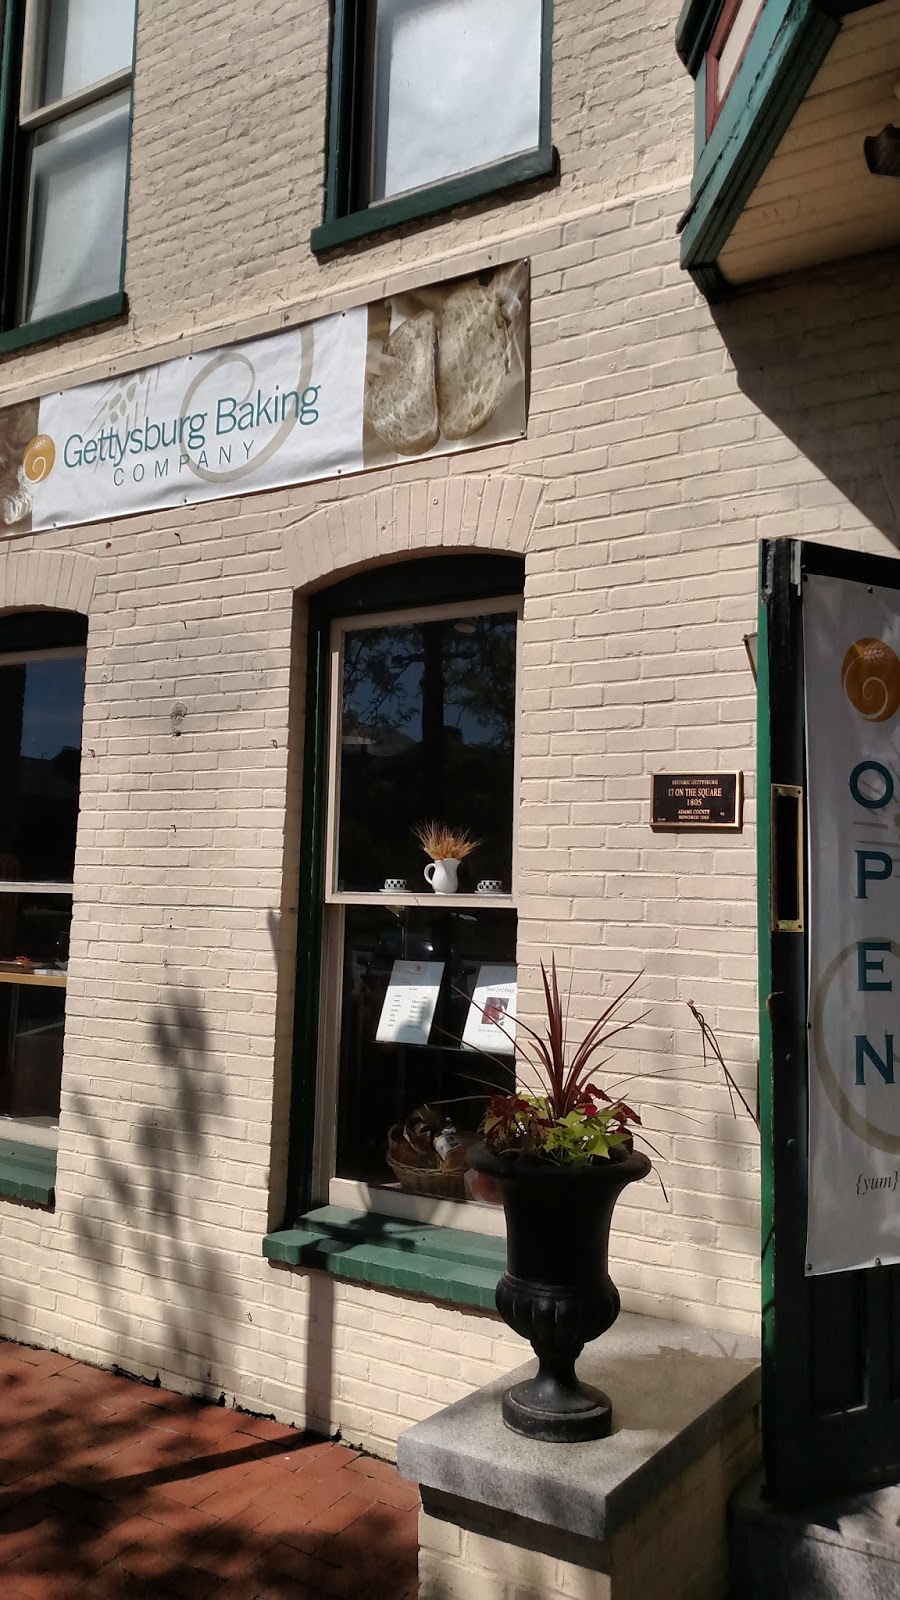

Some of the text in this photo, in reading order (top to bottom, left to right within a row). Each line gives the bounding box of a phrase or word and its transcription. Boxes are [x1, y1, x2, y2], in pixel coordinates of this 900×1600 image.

[63, 385, 321, 469] Gettysburg Baking
[112, 439, 256, 487] COMPANY
[675, 788, 684, 796] ON
[685, 788, 697, 796] THE
[698, 788, 721, 798] SQUARE
[848, 760, 895, 1087] OPEN
